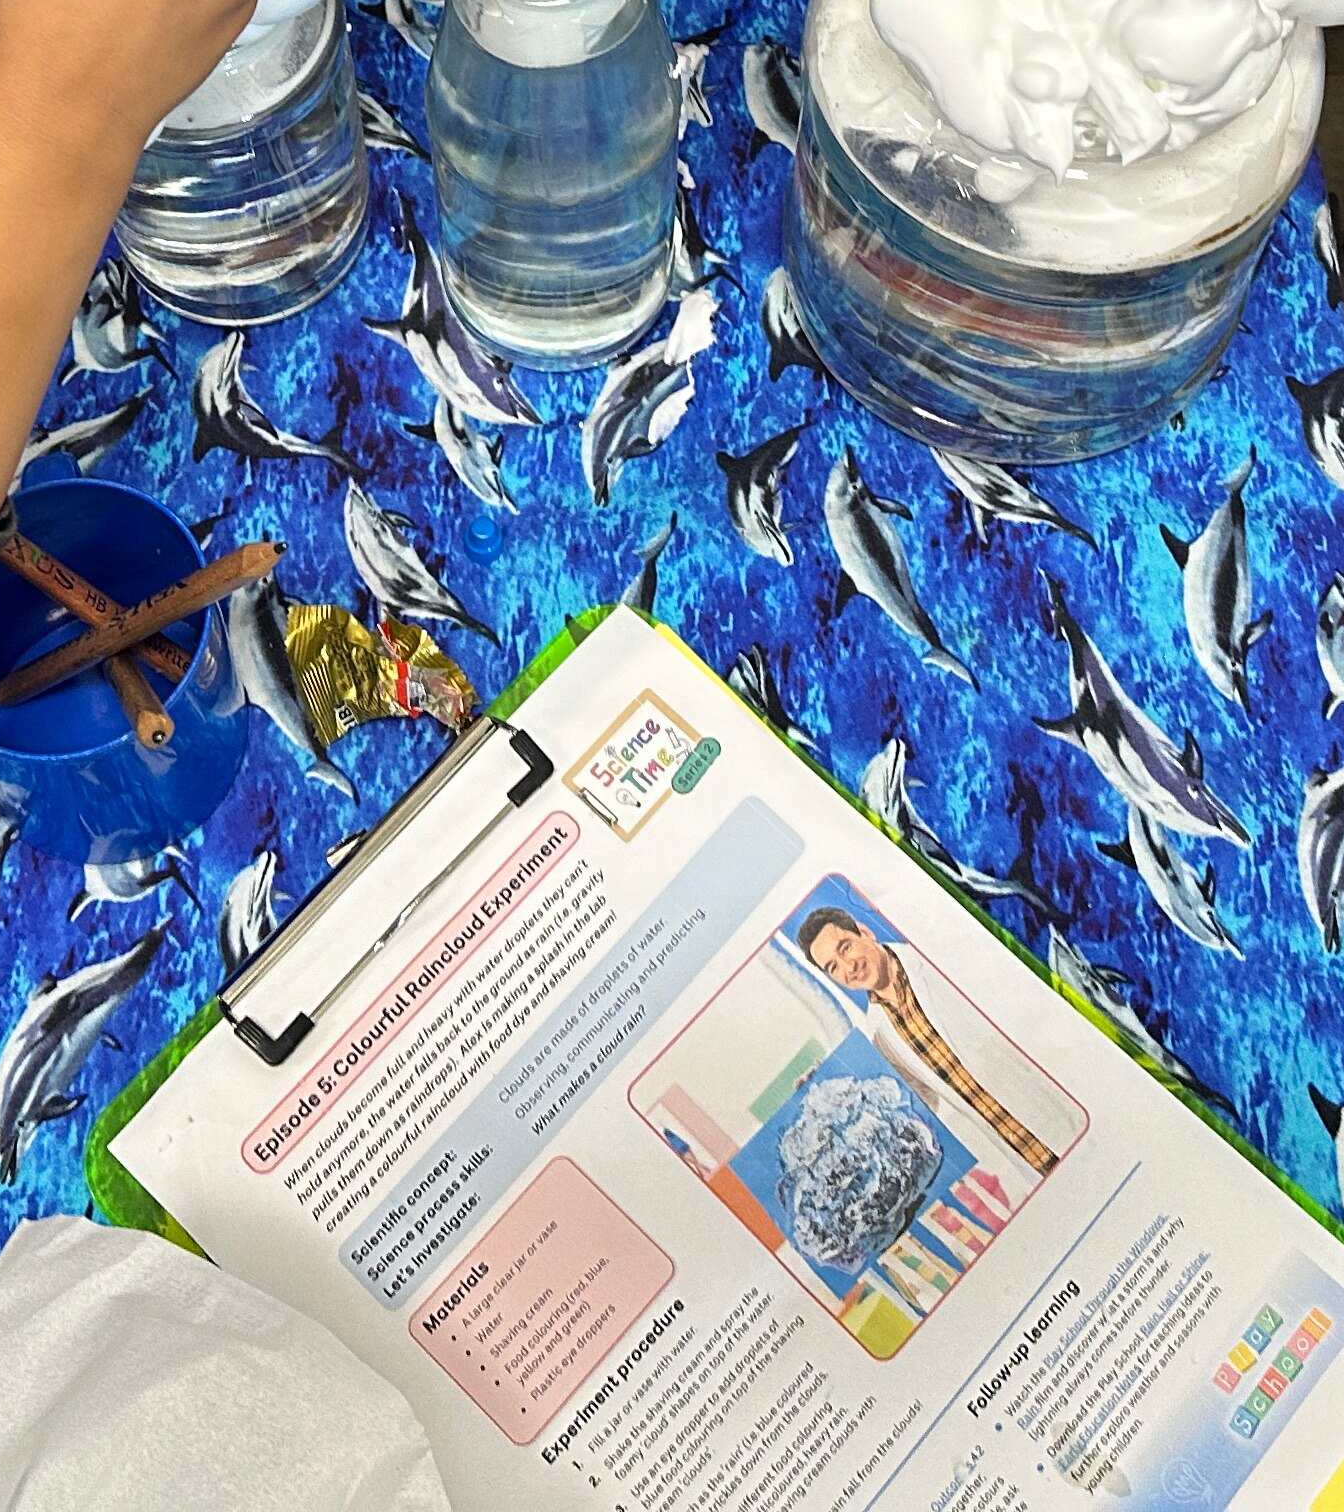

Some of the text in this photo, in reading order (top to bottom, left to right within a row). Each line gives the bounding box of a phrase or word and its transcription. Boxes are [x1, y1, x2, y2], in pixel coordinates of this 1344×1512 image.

[86, 590, 107, 613] HB
[590, 719, 661, 788] Science
[620, 746, 675, 794] Time
[678, 743, 715, 787] Series 2
[253, 827, 568, 1162] Episode 5: Colourful Raincloud Experiment
[283, 859, 589, 1190] When clouds become full and heavy with water droplets they can't
[296, 1172, 323, 1206] hold
[367, 1106, 387, 1129] the
[385, 1072, 415, 1110] water
[414, 1049, 438, 1078] falls
[435, 1023, 462, 1054] back
[460, 1012, 473, 1028] to
[471, 993, 490, 1016] the
[489, 953, 525, 1000] ground
[523, 944, 536, 960] as
[535, 924, 555, 948] rain
[571, 869, 604, 911] gravity
[498, 1063, 536, 1104] Clouds
[533, 1045, 552, 1067] are
[550, 1015, 579, 1048] made
[588, 960, 630, 1006] droplets
[566, 981, 641, 1064] communicating
[637, 958, 658, 985] and
[311, 1187, 339, 1223] pulls
[337, 1158, 366, 1192] them
[365, 1127, 394, 1162] down
[392, 1113, 407, 1132] as
[460, 1029, 484, 1058] Alex
[480, 1019, 493, 1034] is
[491, 980, 529, 1024] making
[526, 973, 535, 985] a
[533, 940, 565, 978] splash
[562, 930, 576, 945] in
[573, 912, 591, 933] the
[588, 895, 607, 916] lab
[326, 909, 617, 1233] creating a colourful raincloud with food dye and shaving cream!
[531, 1004, 646, 1136] What makes a cloud rain?
[350, 1150, 458, 1265] Scientific concept:
[367, 1147, 494, 1282] Science process skills:
[382, 1192, 481, 1299] Let's investigate:
[422, 1262, 489, 1335] Materials
[474, 1311, 503, 1344] Water
[966, 1279, 1081, 1418] Follow-up learning
[1216, 1310, 1276, 1390] Play
[540, 1299, 685, 1465] Experiment procedure
[1232, 1316, 1327, 1435] School
